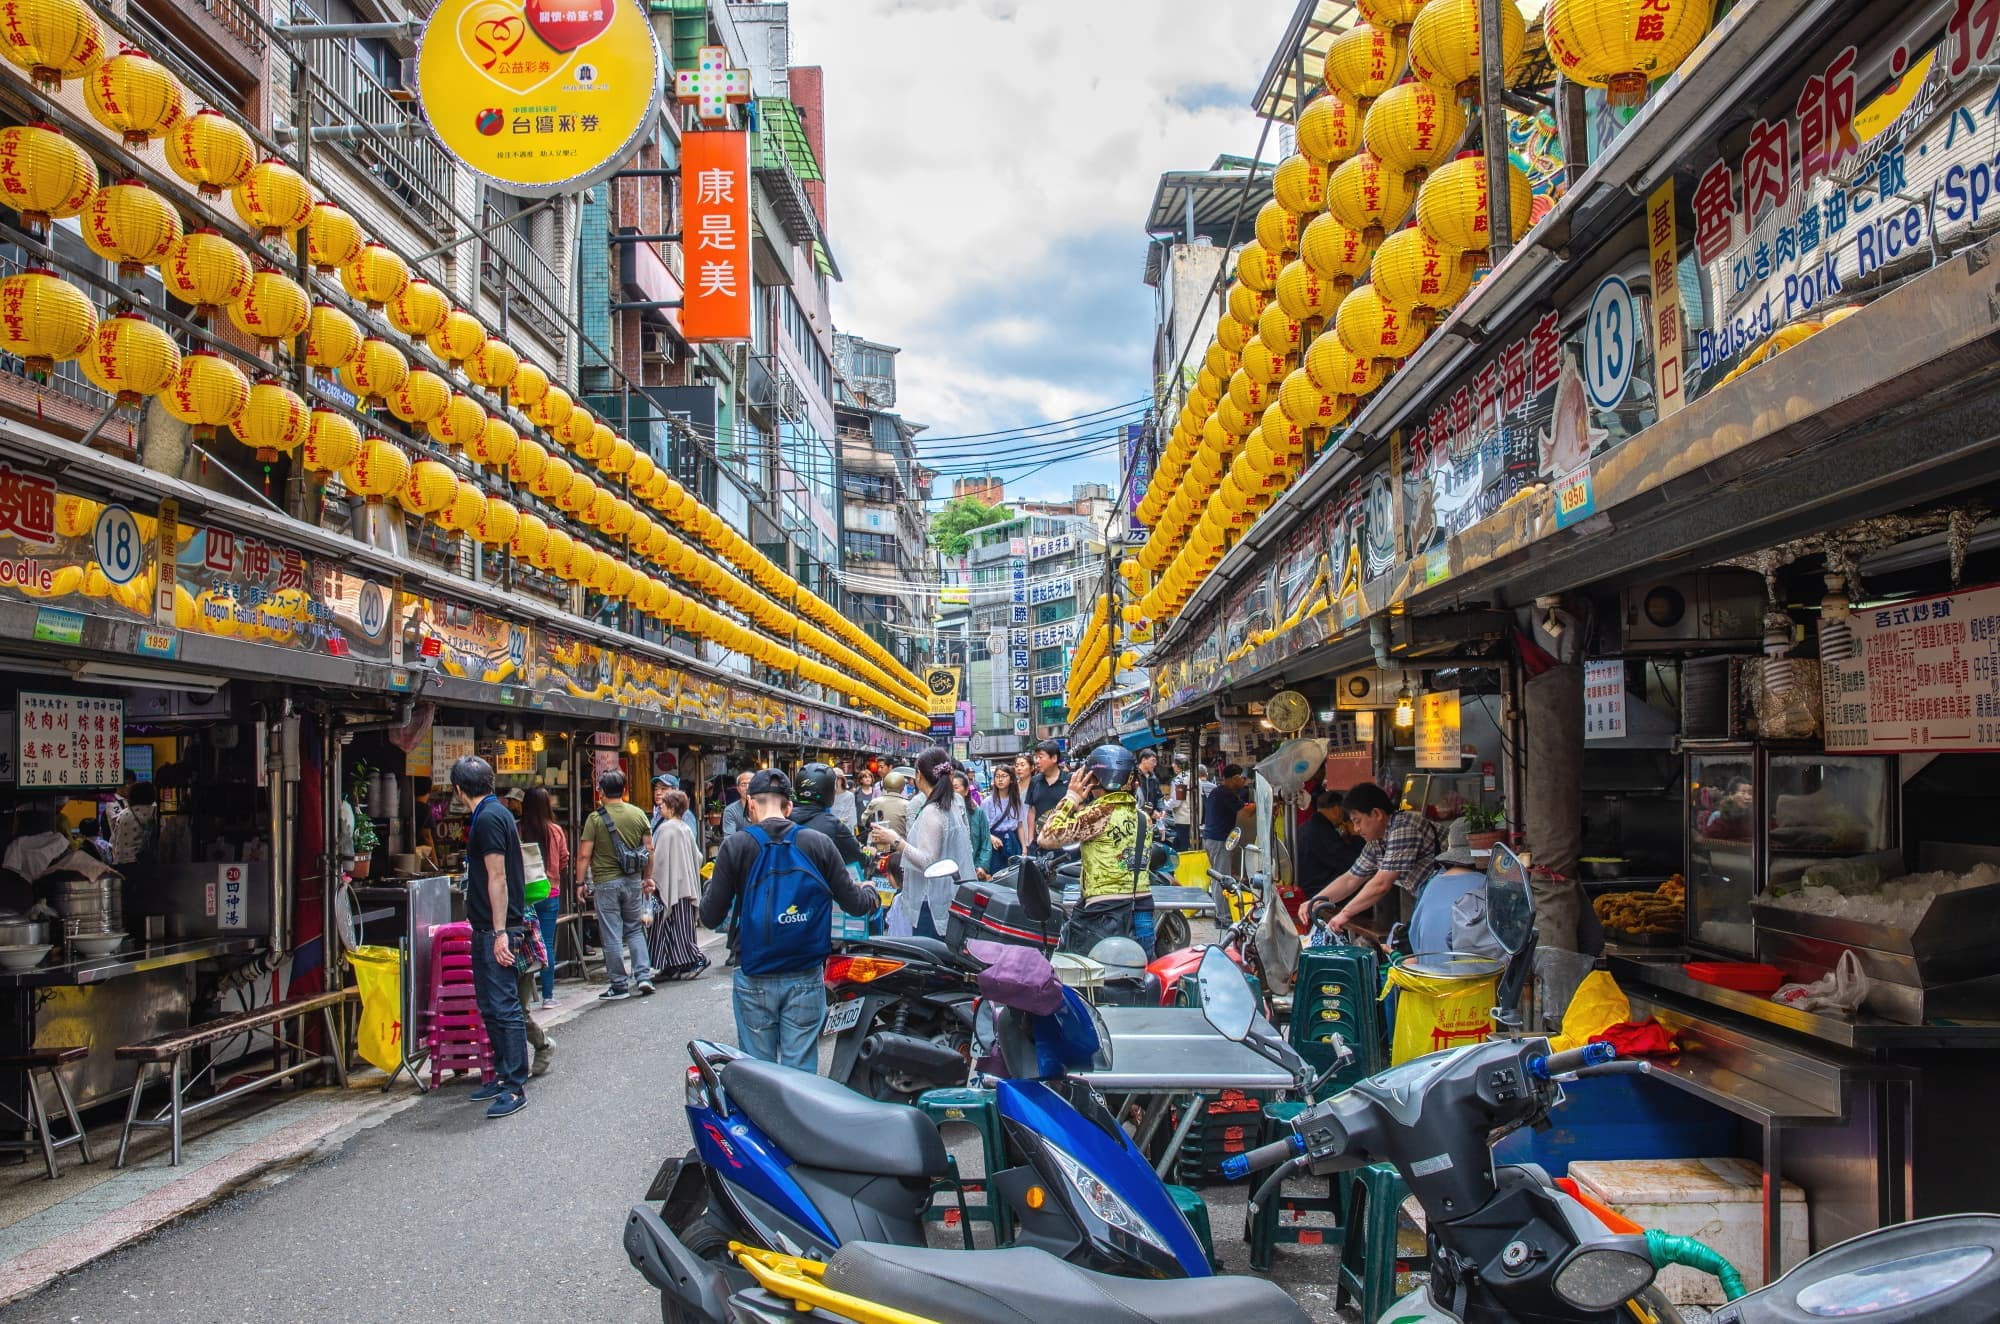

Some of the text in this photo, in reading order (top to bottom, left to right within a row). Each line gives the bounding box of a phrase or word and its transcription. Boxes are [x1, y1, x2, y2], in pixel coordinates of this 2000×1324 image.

[499, 61, 550, 74] 公益彩券
[1413, 94, 1437, 151] 開漳聖王
[697, 167, 738, 298] 康是美
[1651, 200, 1679, 400] 基隆廟口
[1699, 292, 1772, 371] Braised
[1784, 250, 1842, 319] Pork
[1595, 300, 1623, 387] 13
[1373, 486, 1386, 538] 15
[1475, 472, 1518, 520] Noodle
[106, 518, 132, 571] 18
[161, 506, 175, 612] 基隆廟口
[205, 527, 304, 589] 四神湯
[204, 598, 230, 623] Dragon
[232, 603, 258, 625] Festival
[363, 589, 379, 627] 20
[1875, 600, 1951, 628] 各式炒類
[511, 629, 523, 660] 22
[41, 711, 54, 760] 肉粽
[57, 712, 69, 759] 刈包
[78, 714, 90, 770] 綜合湯
[26, 769, 36, 784] 25
[42, 769, 52, 784] 40
[58, 770, 68, 784] 45
[79, 770, 88, 784] 65
[95, 770, 104, 784] 65
[111, 770, 119, 784] 55
[228, 870, 239, 879] 20
[226, 882, 240, 926] 四神湯
[777, 911, 808, 925] Costa
